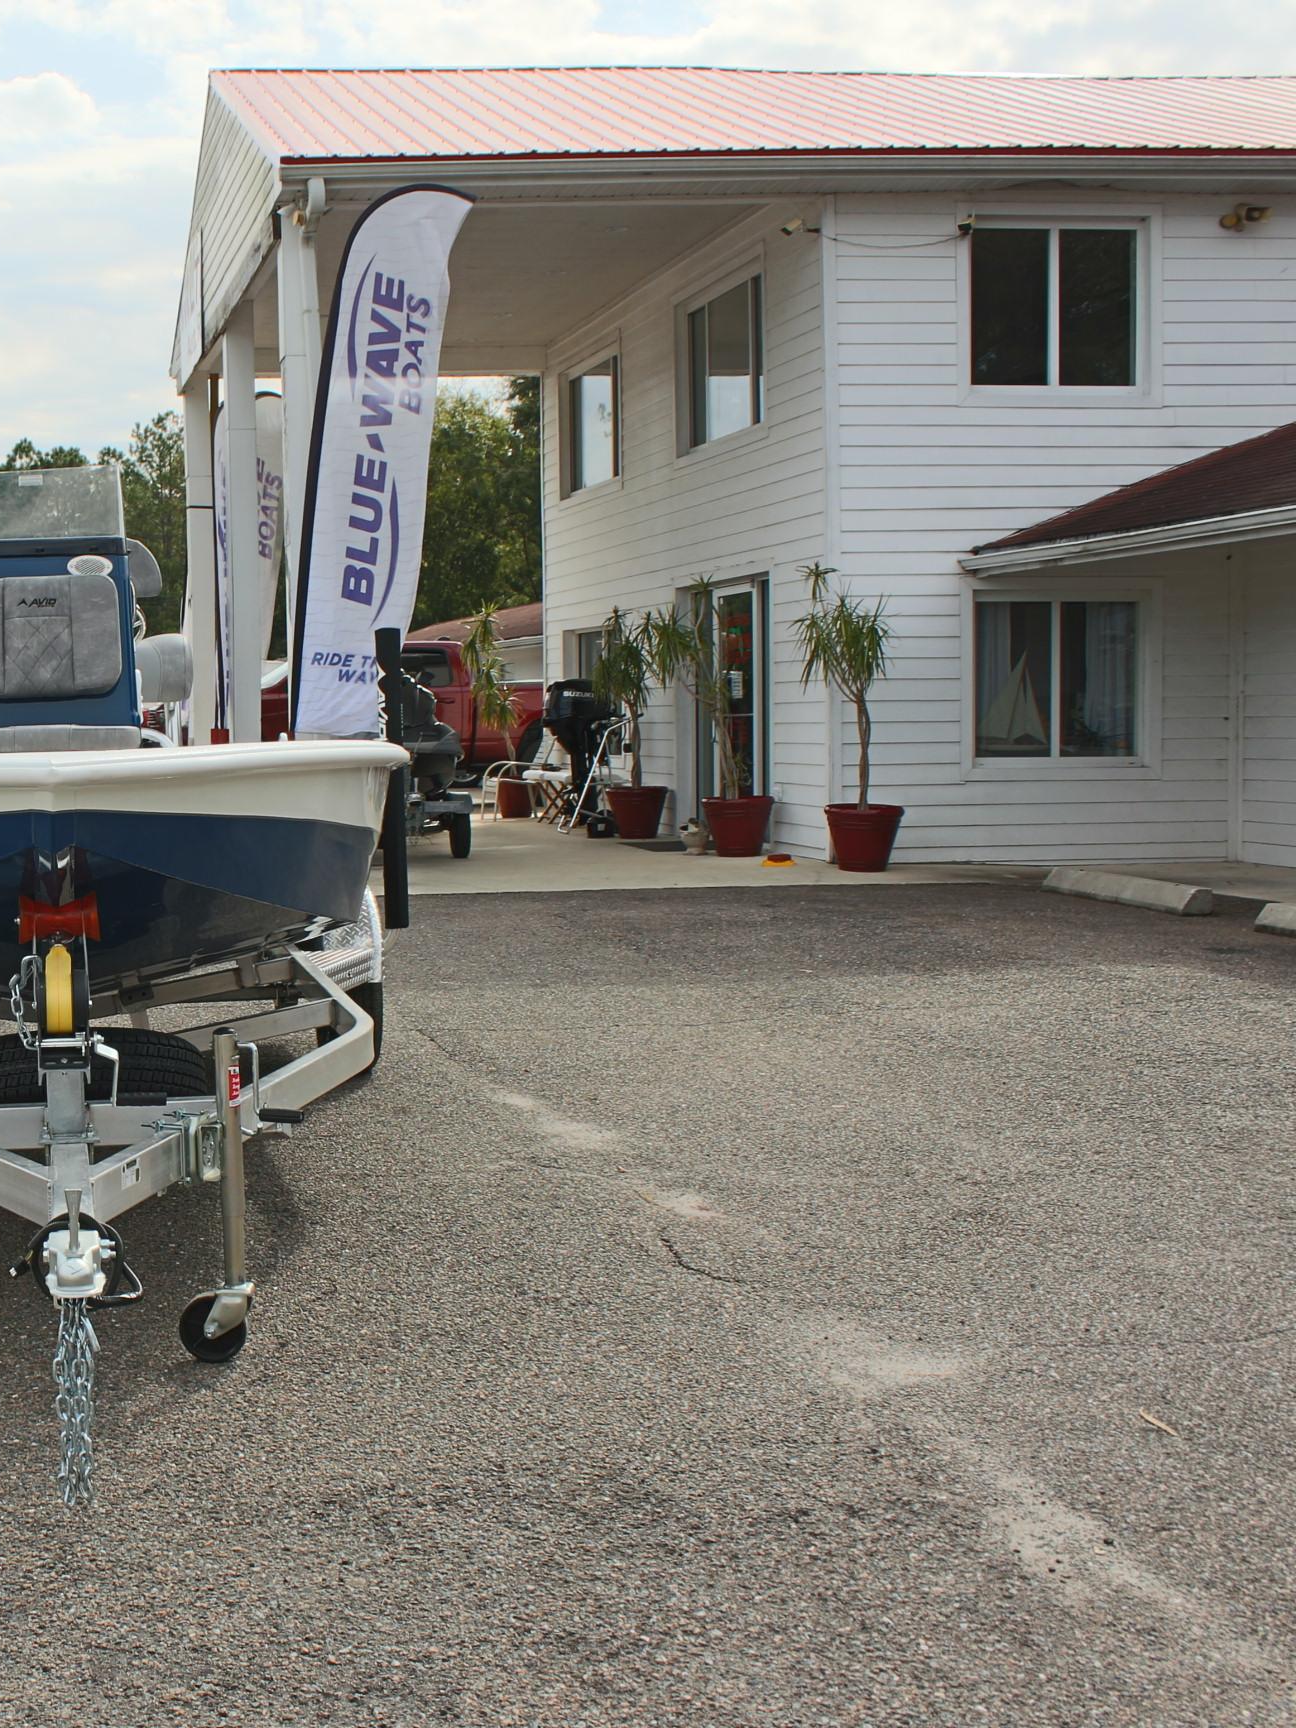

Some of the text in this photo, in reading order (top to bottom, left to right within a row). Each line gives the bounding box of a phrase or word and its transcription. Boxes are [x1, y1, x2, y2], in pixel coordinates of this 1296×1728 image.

[398, 293, 431, 415] BOATS
[341, 271, 405, 607] BLUE WAVE
[258, 471, 283, 560] BOATS
[311, 652, 355, 668] RIDE
